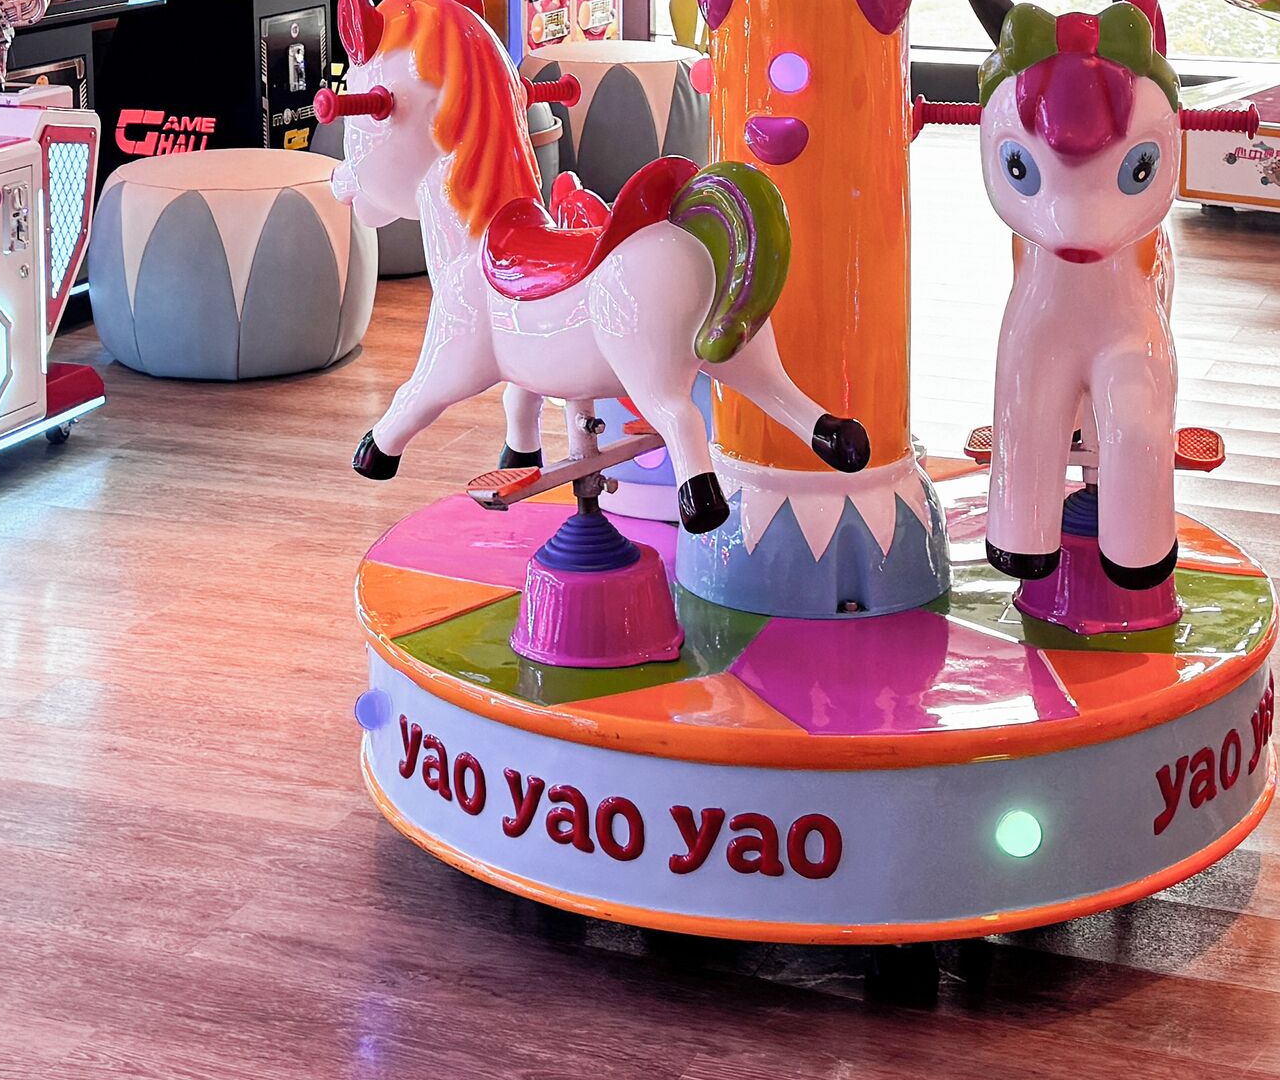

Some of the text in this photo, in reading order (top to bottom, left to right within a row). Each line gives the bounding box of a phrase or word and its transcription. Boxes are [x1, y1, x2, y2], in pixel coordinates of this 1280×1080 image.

[398, 713, 842, 880] yao yao yao
[1153, 728, 1242, 836] yao
